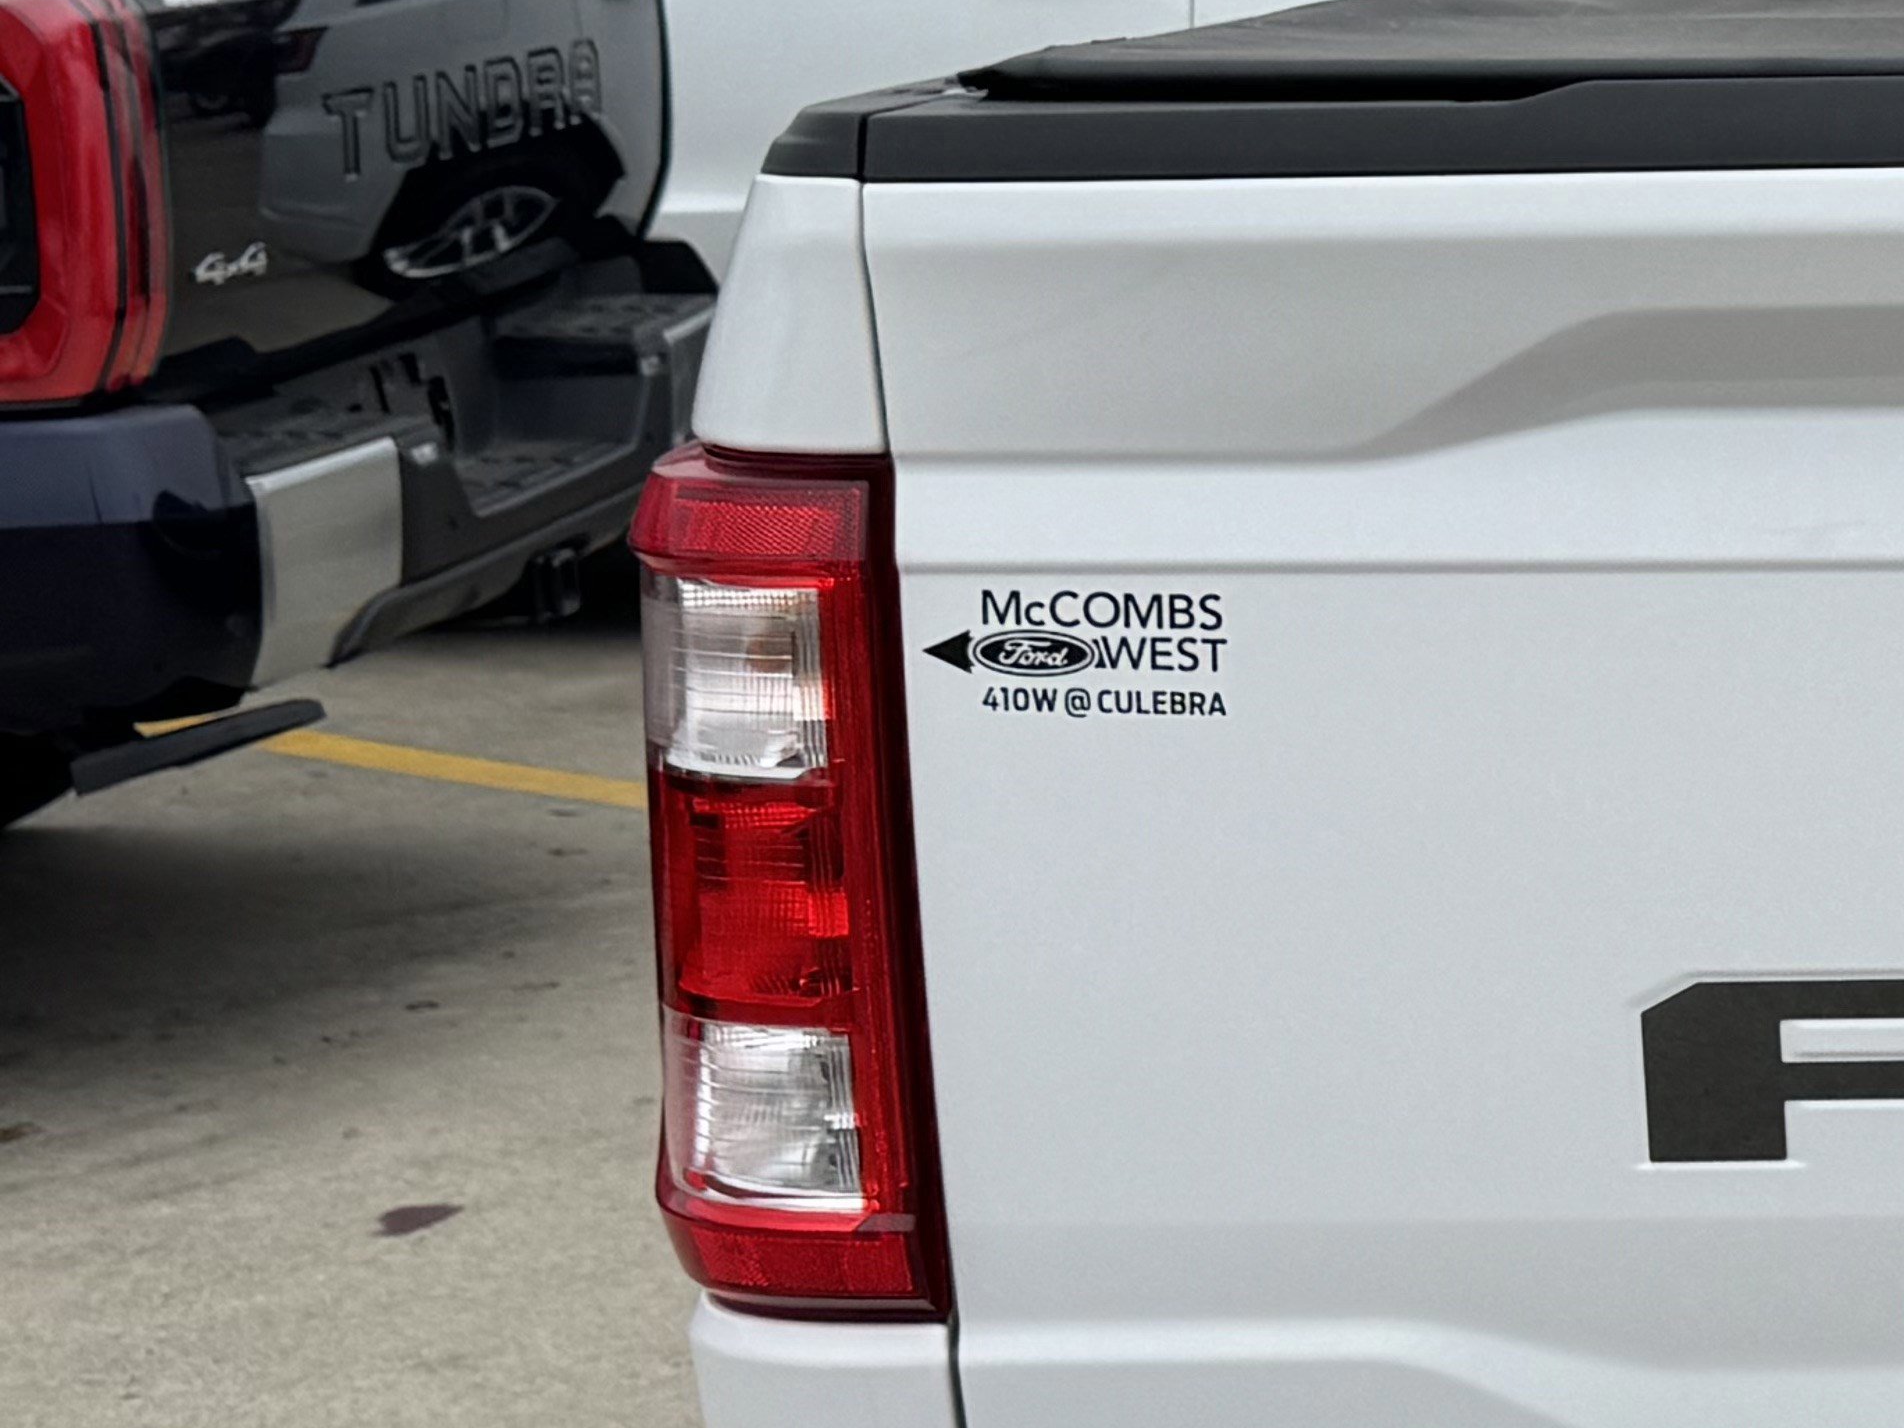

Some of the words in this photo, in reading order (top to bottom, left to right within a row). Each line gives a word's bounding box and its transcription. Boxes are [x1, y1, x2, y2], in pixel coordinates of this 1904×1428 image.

[321, 38, 602, 182] TUNDRA
[195, 241, 267, 286] 4x4
[981, 589, 1223, 630] McCOMBS
[999, 639, 1069, 666] Ford
[1099, 635, 1228, 673] WEST
[1097, 689, 1227, 716] CULEBRA
